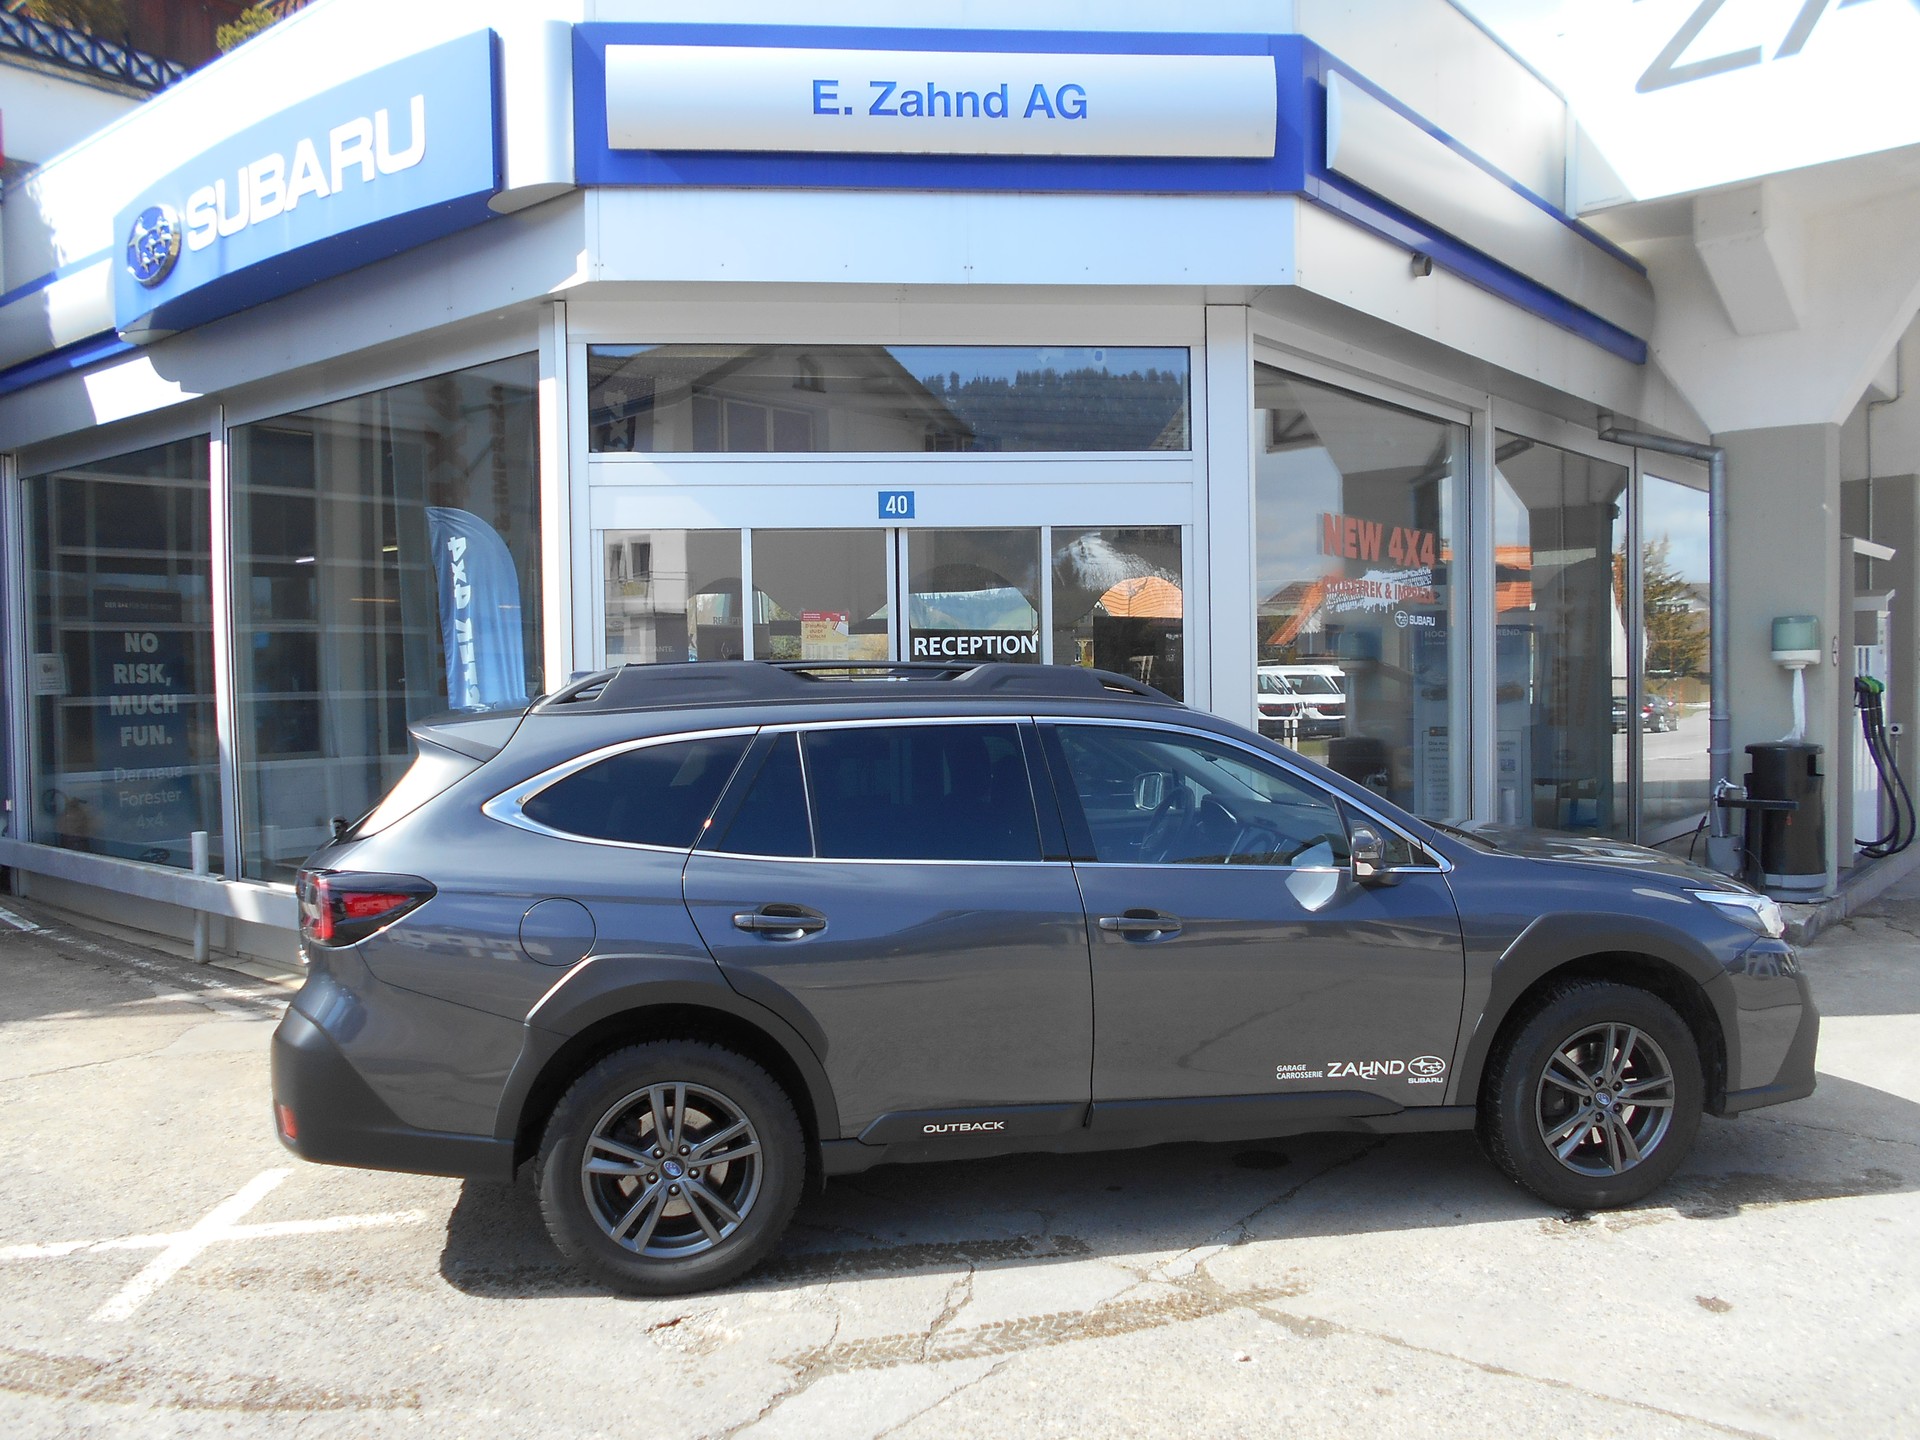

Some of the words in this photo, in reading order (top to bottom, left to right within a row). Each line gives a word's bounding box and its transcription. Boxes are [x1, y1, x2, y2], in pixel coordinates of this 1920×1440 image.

[812, 79, 853, 116] E.
[868, 80, 1009, 118] Zahnd
[1023, 83, 1088, 120] AG
[185, 93, 426, 252] SUBARU
[885, 495, 908, 514] 40
[1323, 512, 1383, 562] NEW
[1388, 527, 1436, 569] 4X4
[1385, 582, 1393, 599] &
[1409, 614, 1436, 626] SUBARU
[124, 632, 159, 653] NO
[914, 635, 1037, 655] RECEPTION
[112, 663, 172, 687] RISK,
[109, 693, 178, 716] MUCH
[120, 724, 173, 747] FUN.
[114, 767, 140, 783] Der
[147, 766, 183, 780] neue
[119, 789, 182, 807] Forester
[1276, 1063, 1307, 1072] GARAGE
[1276, 1070, 1323, 1080] CARROSSERIE
[1327, 1060, 1405, 1079] ZAHND
[923, 1121, 1005, 1133] OUTBACK
